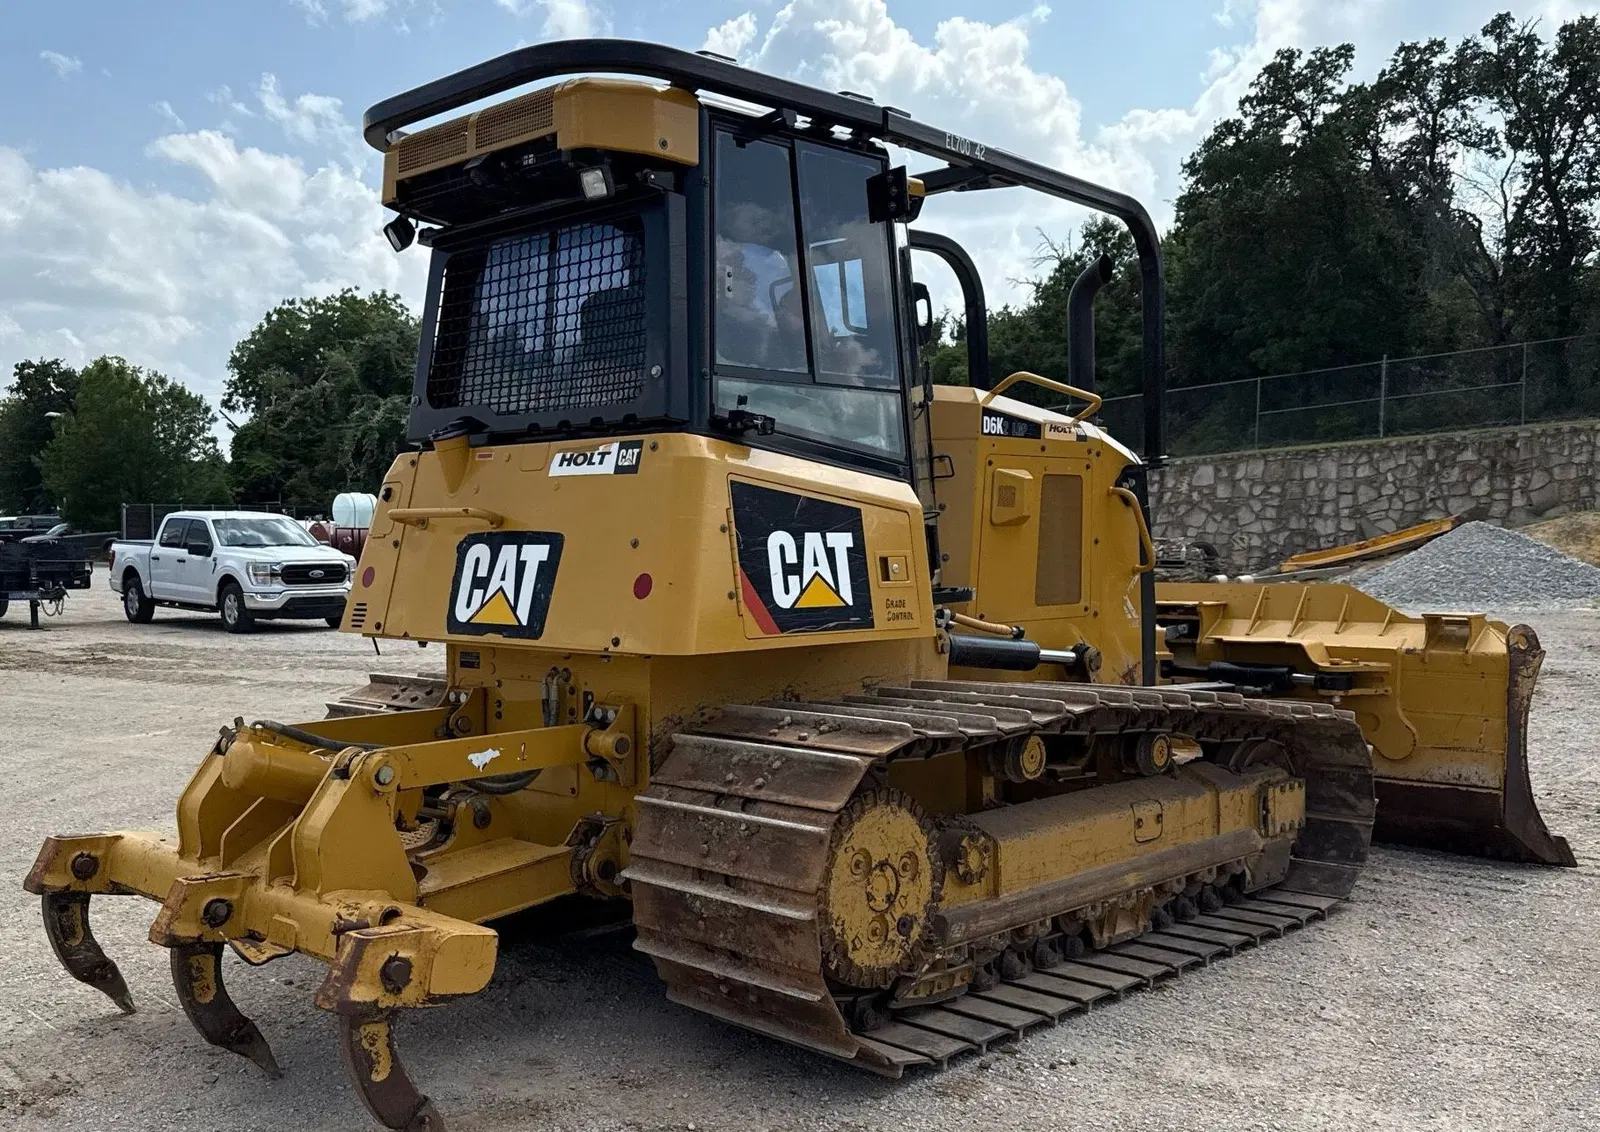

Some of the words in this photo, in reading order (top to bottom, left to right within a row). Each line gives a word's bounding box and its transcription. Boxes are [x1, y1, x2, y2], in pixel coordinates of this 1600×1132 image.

[945, 132, 970, 156] EL700
[975, 143, 986, 161] 42
[1049, 423, 1073, 434] HOLT
[558, 451, 612, 467] HOLT
[618, 448, 640, 466] CAT
[767, 530, 854, 609] CAT
[455, 543, 550, 626] CAT
[885, 598, 906, 609] GRADE
[887, 610, 914, 622] CONTROL
